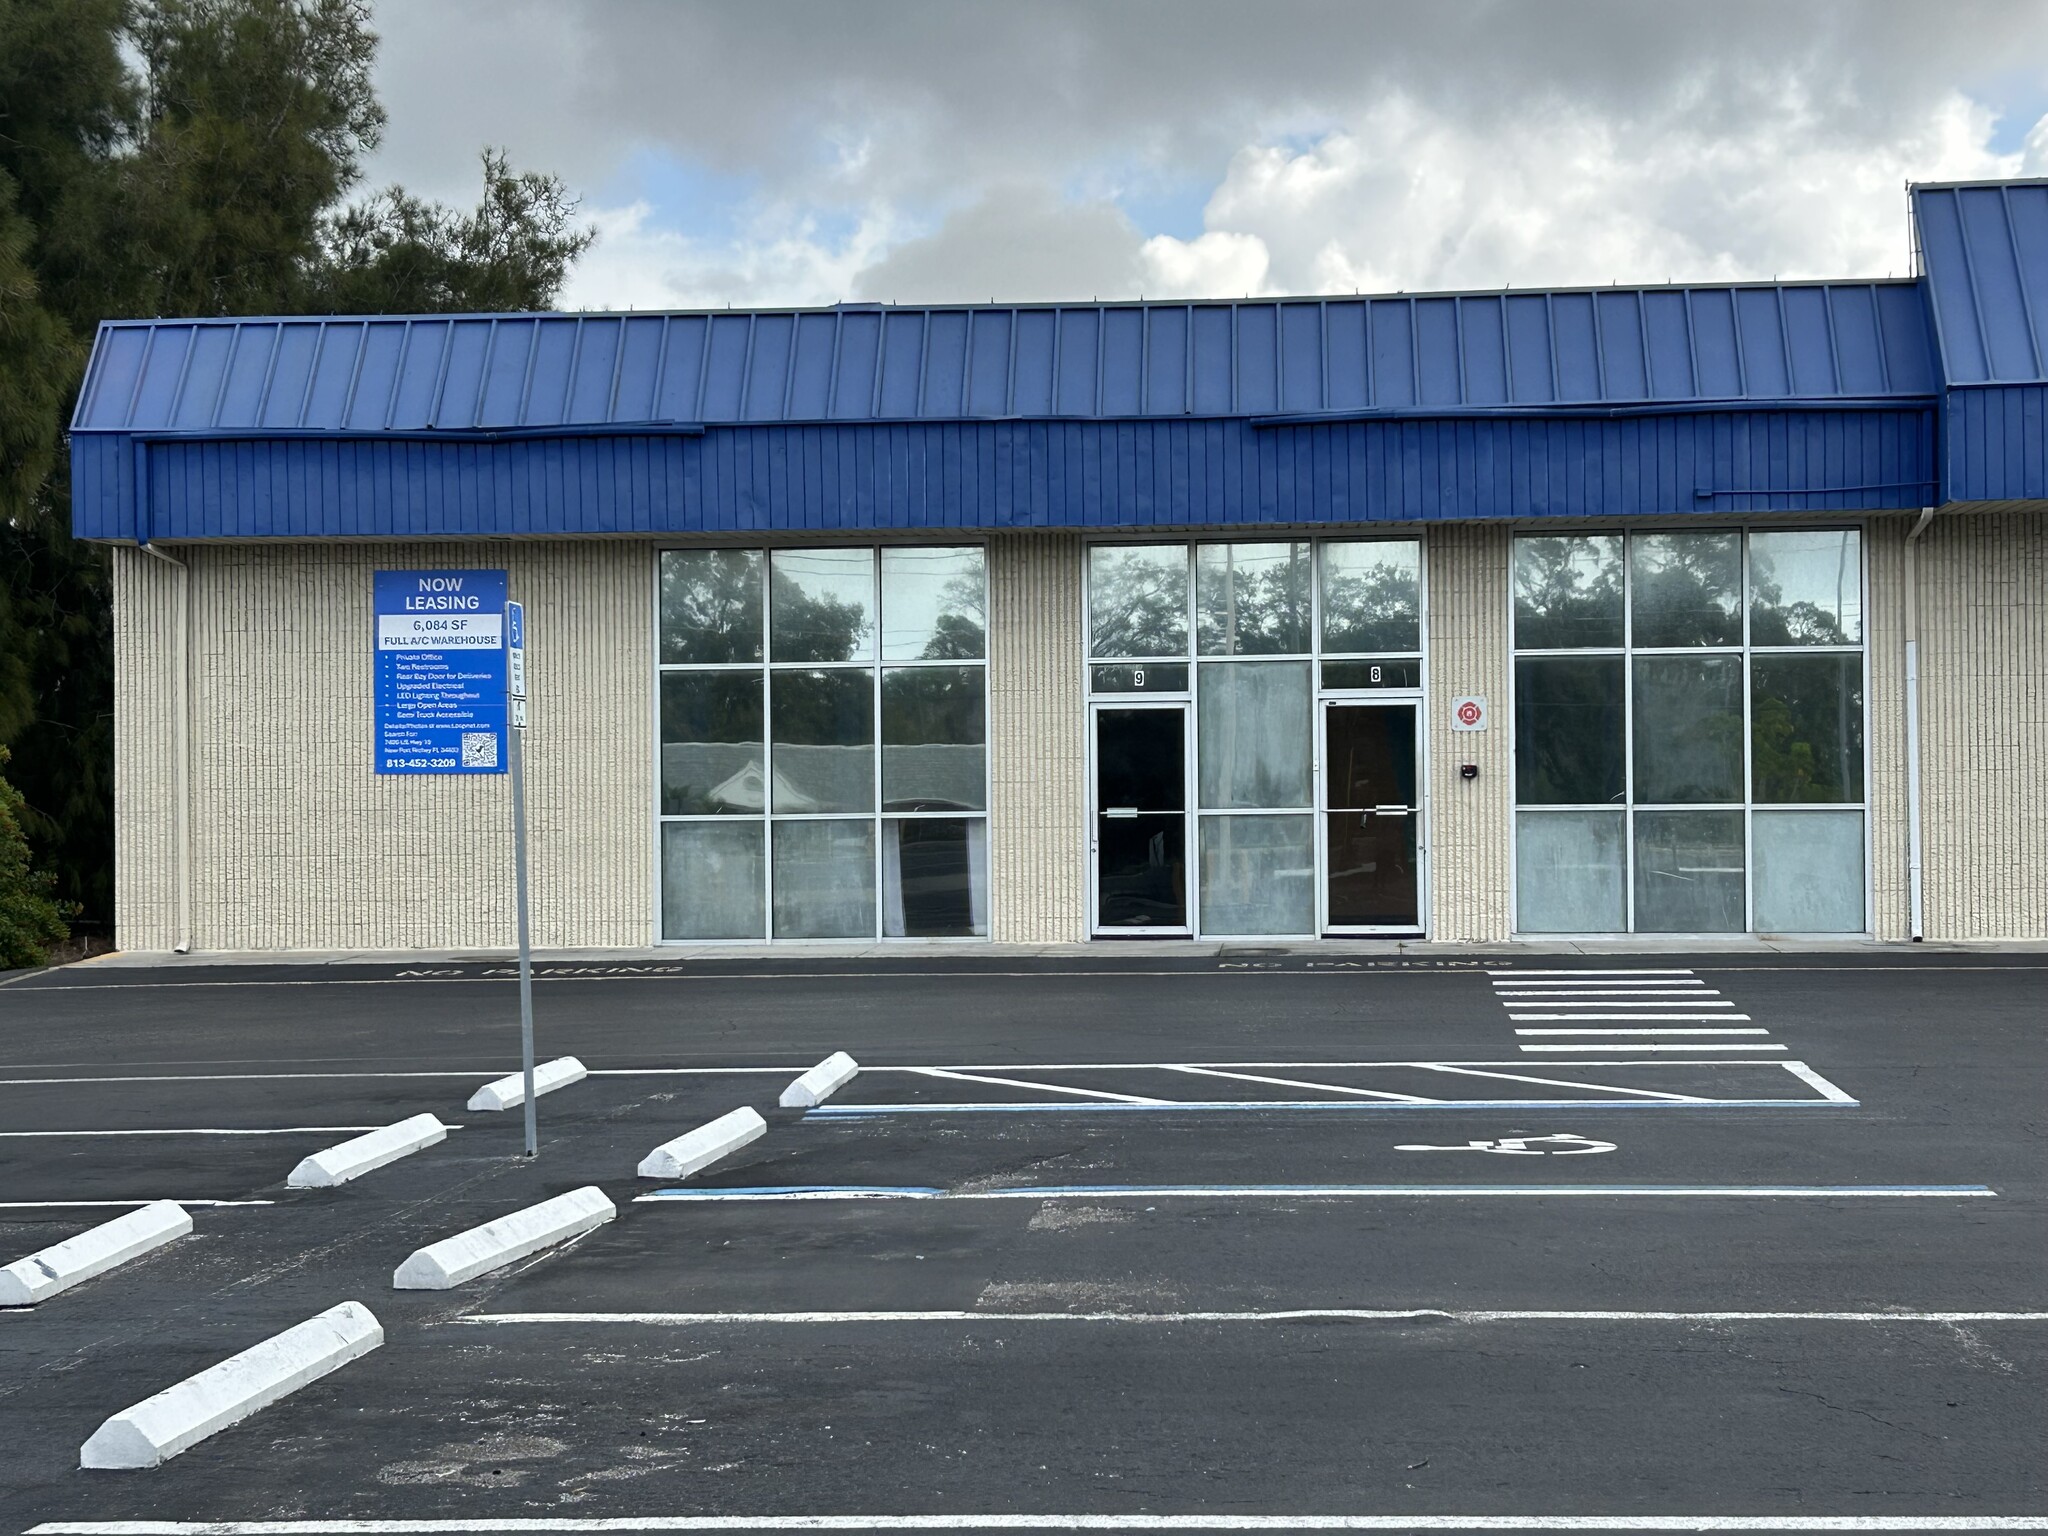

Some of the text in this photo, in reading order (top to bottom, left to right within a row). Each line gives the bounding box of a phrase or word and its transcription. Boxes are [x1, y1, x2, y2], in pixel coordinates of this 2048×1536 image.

[419, 578, 463, 592] NOW
[405, 596, 479, 610] LEASING
[413, 620, 468, 632] 6,084 SF
[384, 636, 497, 645] FULL A/C WAREHOUSE
[414, 673, 427, 681] Bay
[1136, 672, 1142, 684] 9
[1372, 668, 1380, 680] 8
[412, 692, 440, 700] Lighting
[440, 692, 480, 700] Throughout
[396, 702, 416, 710] Large
[386, 758, 456, 768] 813-452-3209
[395, 969, 464, 977] NO
